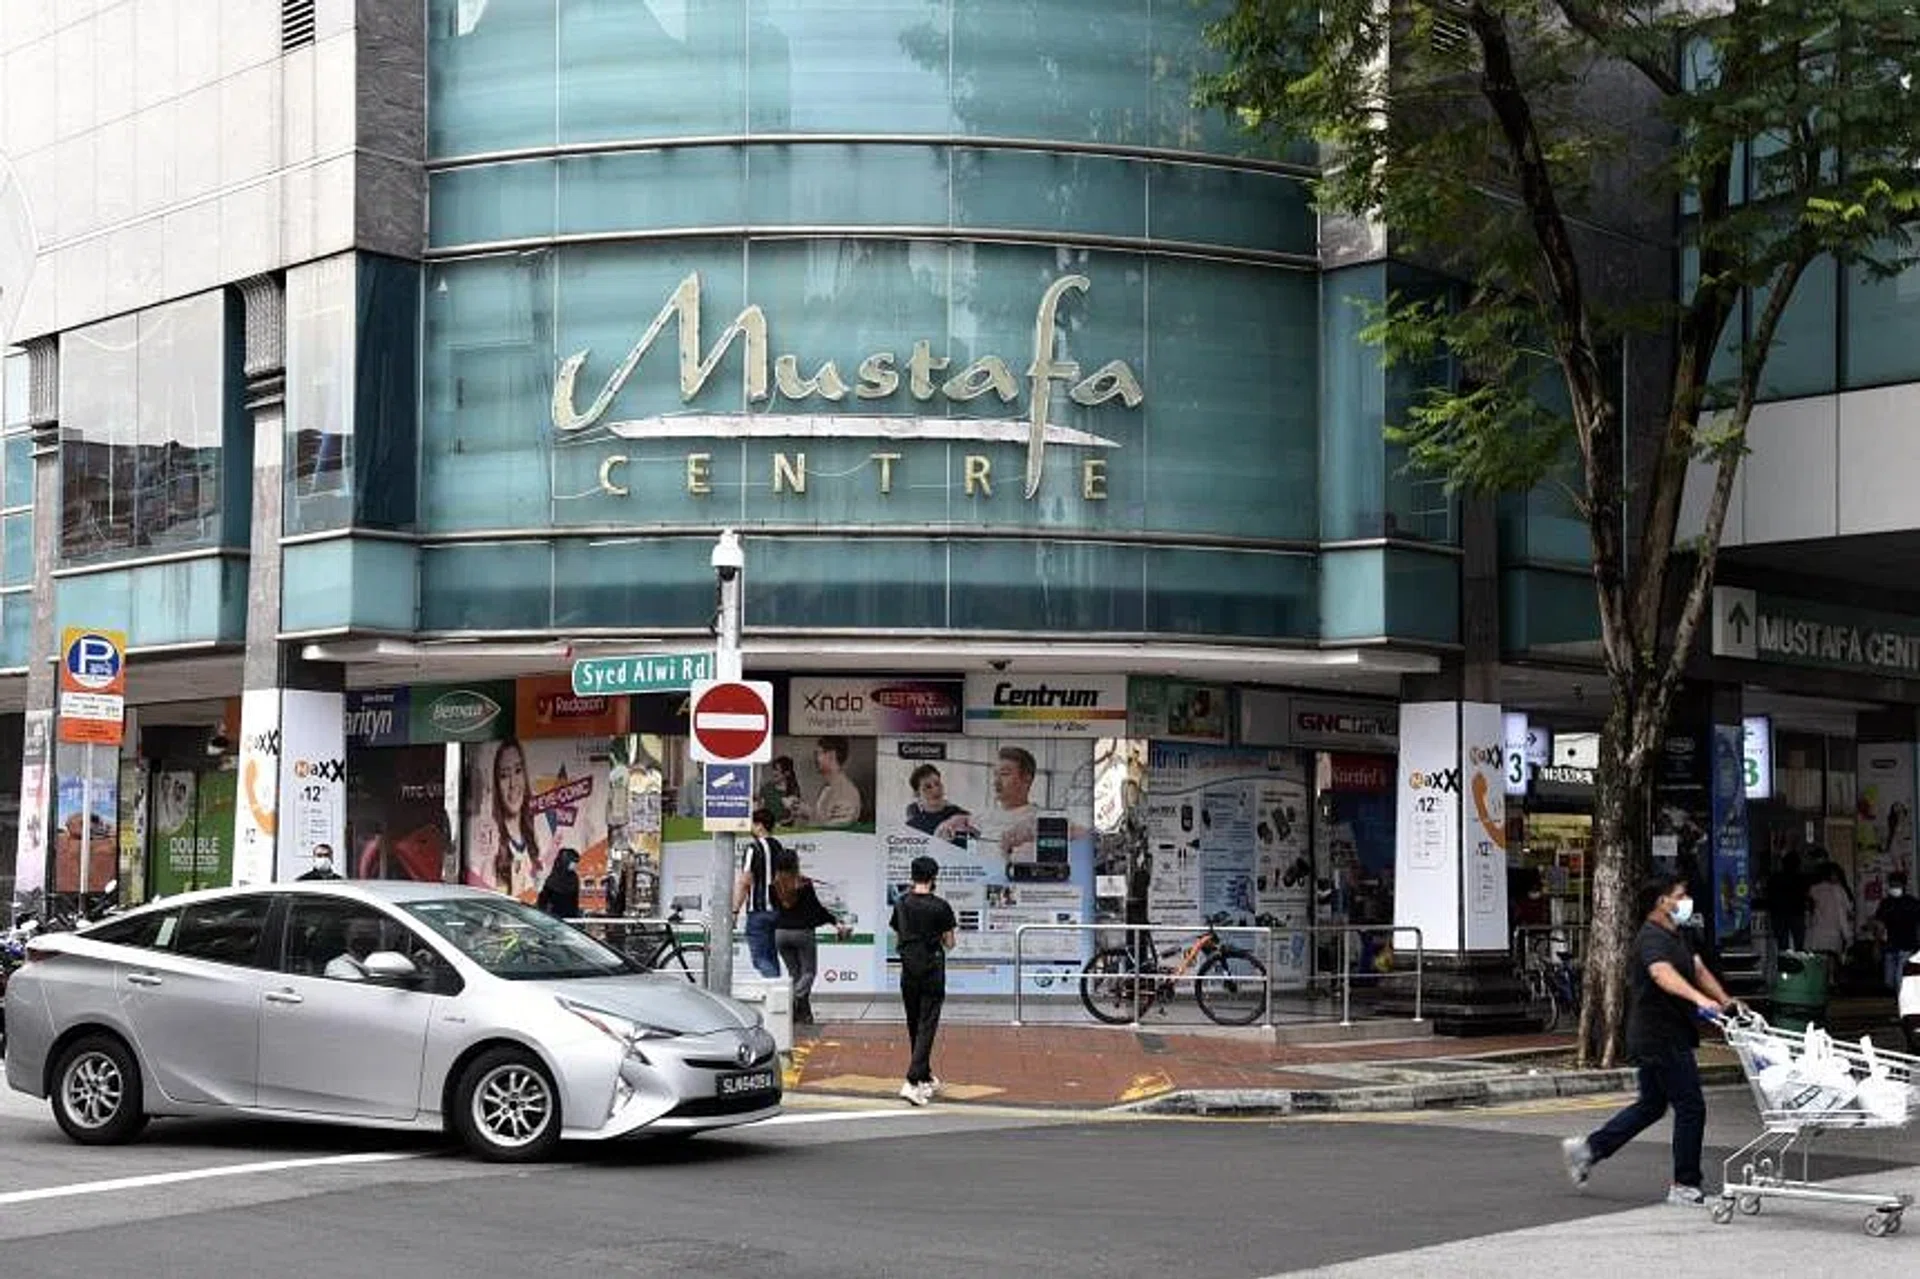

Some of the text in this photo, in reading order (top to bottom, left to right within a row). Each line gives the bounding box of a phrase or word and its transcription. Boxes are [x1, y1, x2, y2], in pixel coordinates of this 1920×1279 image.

[552, 270, 1143, 500] Mustafa
[599, 452, 1108, 500] CENTRE
[1760, 615, 1863, 664] MUSTAFA
[79, 639, 115, 674] P
[583, 656, 705, 692] Syed Alwi Rd
[994, 682, 1100, 707] Centrum
[1297, 713, 1351, 734] GNC
[1509, 753, 1523, 785] 3
[170, 837, 219, 854] DOUBLE
[840, 970, 858, 981] BD
